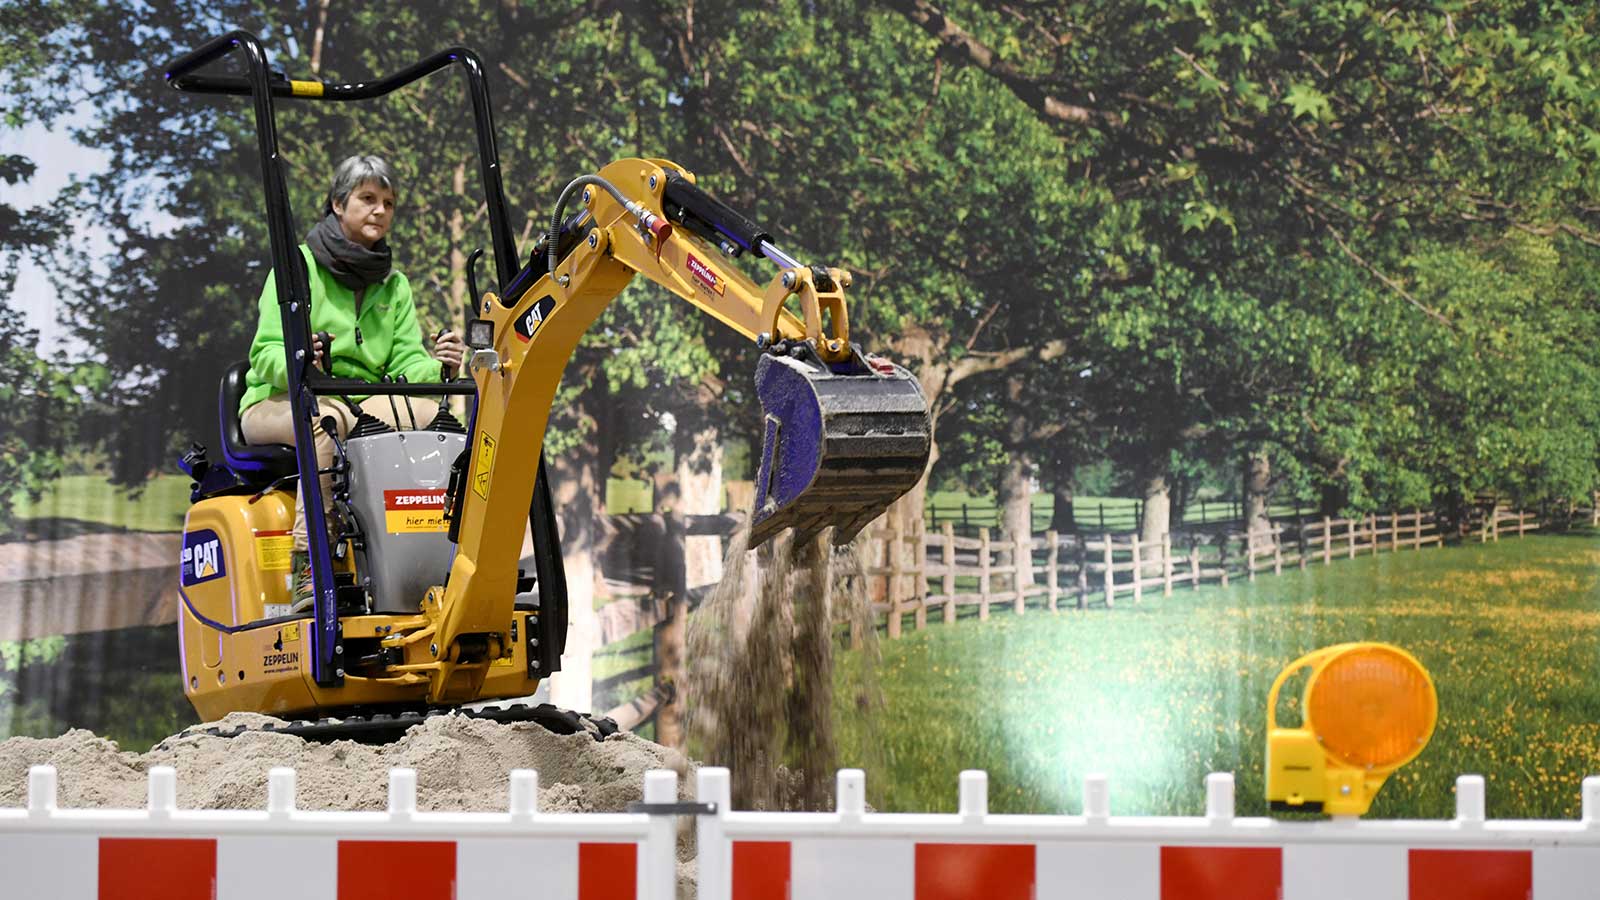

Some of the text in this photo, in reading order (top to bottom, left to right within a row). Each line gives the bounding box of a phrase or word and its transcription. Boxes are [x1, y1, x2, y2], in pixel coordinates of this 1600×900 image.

[525, 302, 543, 337] CAT
[395, 495, 445, 505] ZEPPELIN
[406, 516, 451, 525] hier miete
[194, 539, 219, 579] CAT
[263, 652, 299, 667] ZEPPELIN
